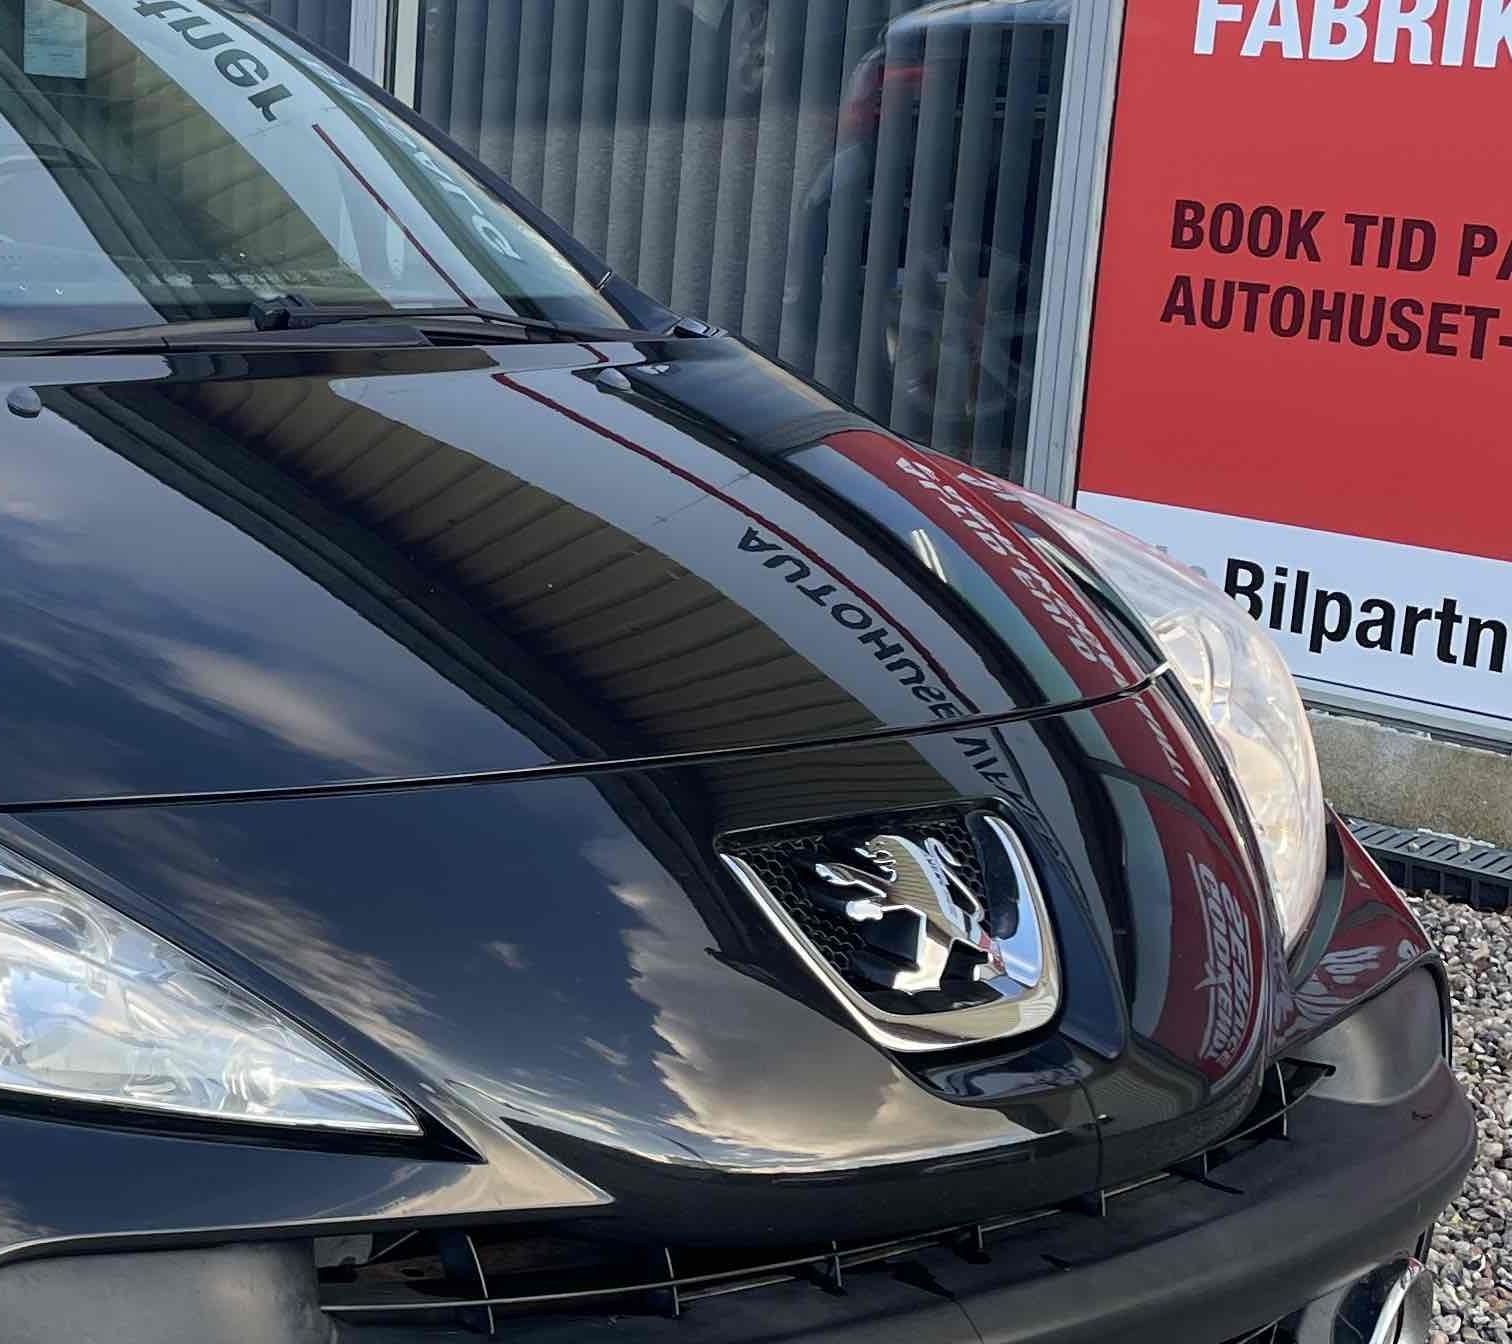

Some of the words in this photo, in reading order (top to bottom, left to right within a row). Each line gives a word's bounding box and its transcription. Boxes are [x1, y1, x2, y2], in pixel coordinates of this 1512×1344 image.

[1170, 199, 1326, 262] BOOK
[1344, 213, 1437, 272] TID
[1223, 557, 1508, 674] Bilpartn
